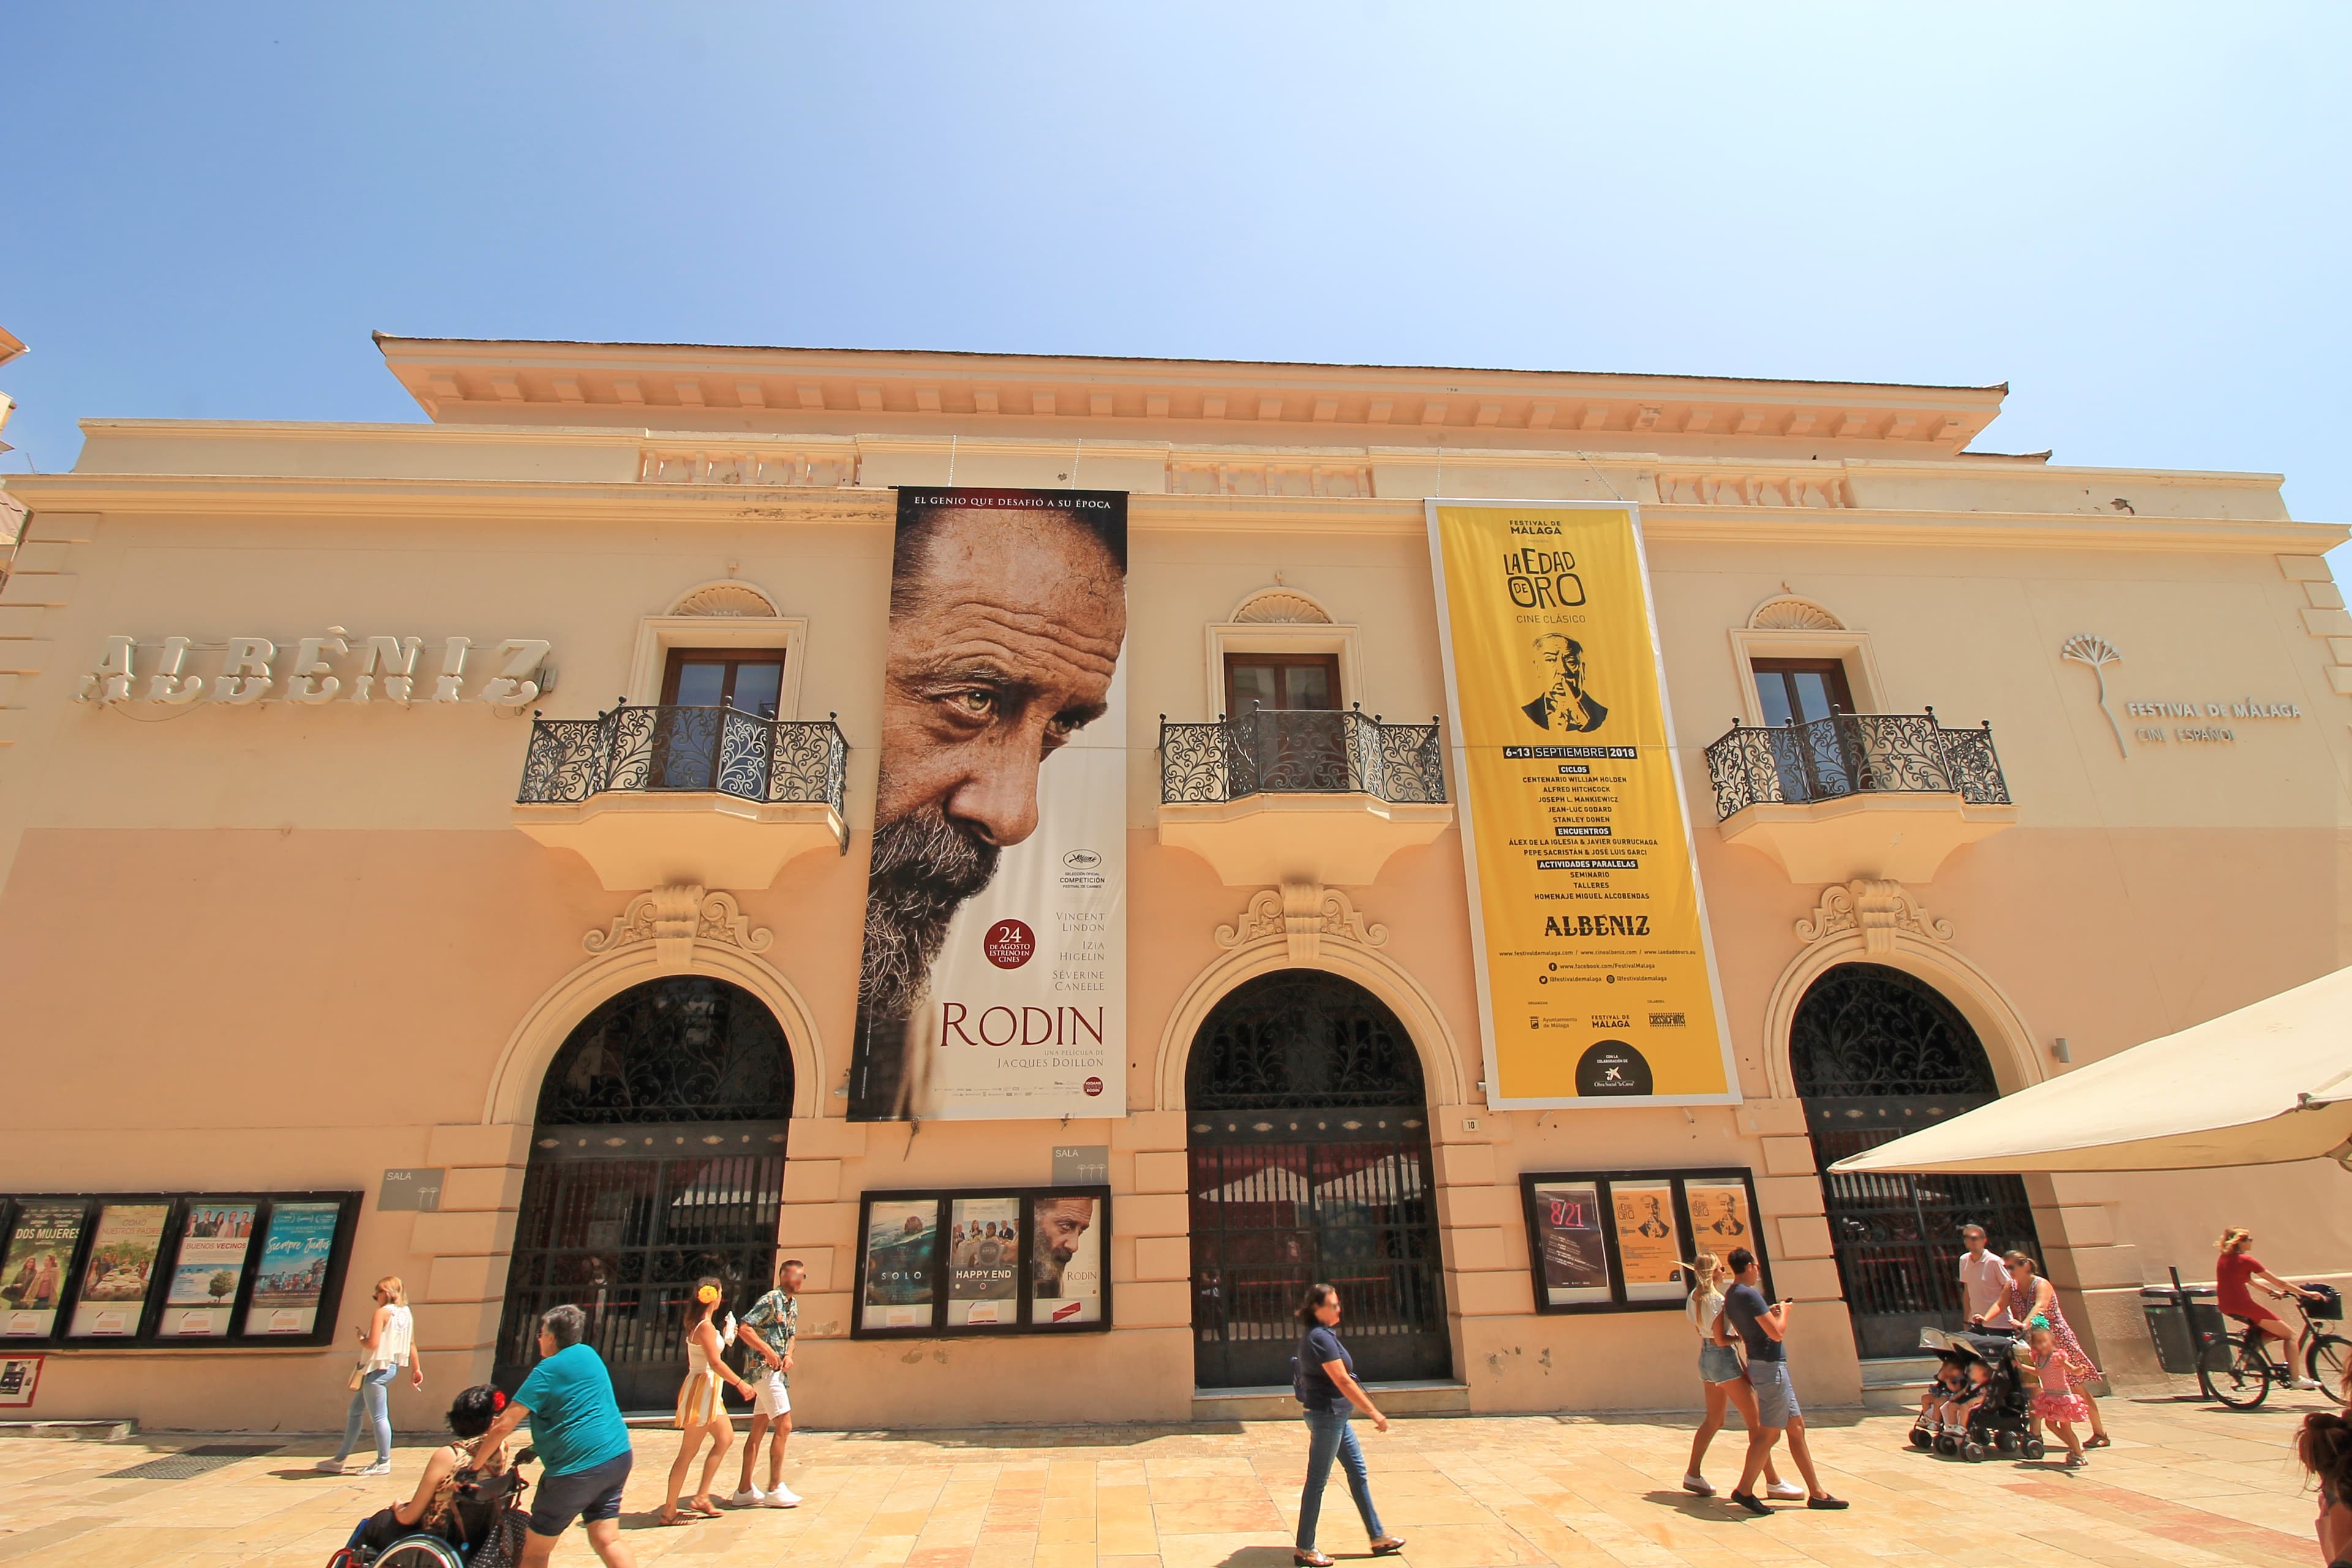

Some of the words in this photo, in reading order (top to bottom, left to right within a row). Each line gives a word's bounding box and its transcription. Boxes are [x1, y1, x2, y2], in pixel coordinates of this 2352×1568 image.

[970, 498, 993, 507] QUE
[998, 498, 1044, 507] DESAFIÓ
[1076, 499, 1111, 509] ÉPOCA
[1510, 526, 1562, 535] MÁLAGA
[1503, 553, 1522, 575] LA
[1521, 548, 1575, 575] EDAD
[1507, 573, 1586, 609] ORO
[1513, 583, 1528, 594] DE
[1544, 614, 1586, 624] CLÁSICO
[69, 625, 551, 706] ALBÉNIZ
[2127, 703, 2203, 717] FESTIVAL
[2207, 703, 2230, 717] DE
[2233, 696, 2302, 717] MÁLAGA
[1506, 748, 1530, 757] 6-13
[1536, 747, 1605, 757] SEPTIEMBRE
[1610, 748, 1635, 757] 2018
[1056, 912, 1105, 921] VINCENT
[1063, 923, 1105, 932] LINDON
[1544, 914, 1650, 937] ALBÉNIZ
[998, 926, 1022, 943] 24
[1052, 970, 1104, 979] SÉVERINE
[1055, 982, 1105, 990] CANEELE
[940, 1002, 1104, 1047] RODIN
[997, 1058, 1048, 1069] JACQUES
[1052, 1058, 1104, 1068] DOILLON
[1055, 1149, 1079, 1158] SALA
[386, 1172, 412, 1180] SALA
[1550, 1201, 1585, 1227] 8/21
[15, 1228, 36, 1238] DOS
[36, 1227, 80, 1239] MUJERES
[956, 1270, 989, 1279] HAPPY
[992, 1270, 1012, 1278] END
[1068, 1271, 1097, 1281] RODIN
